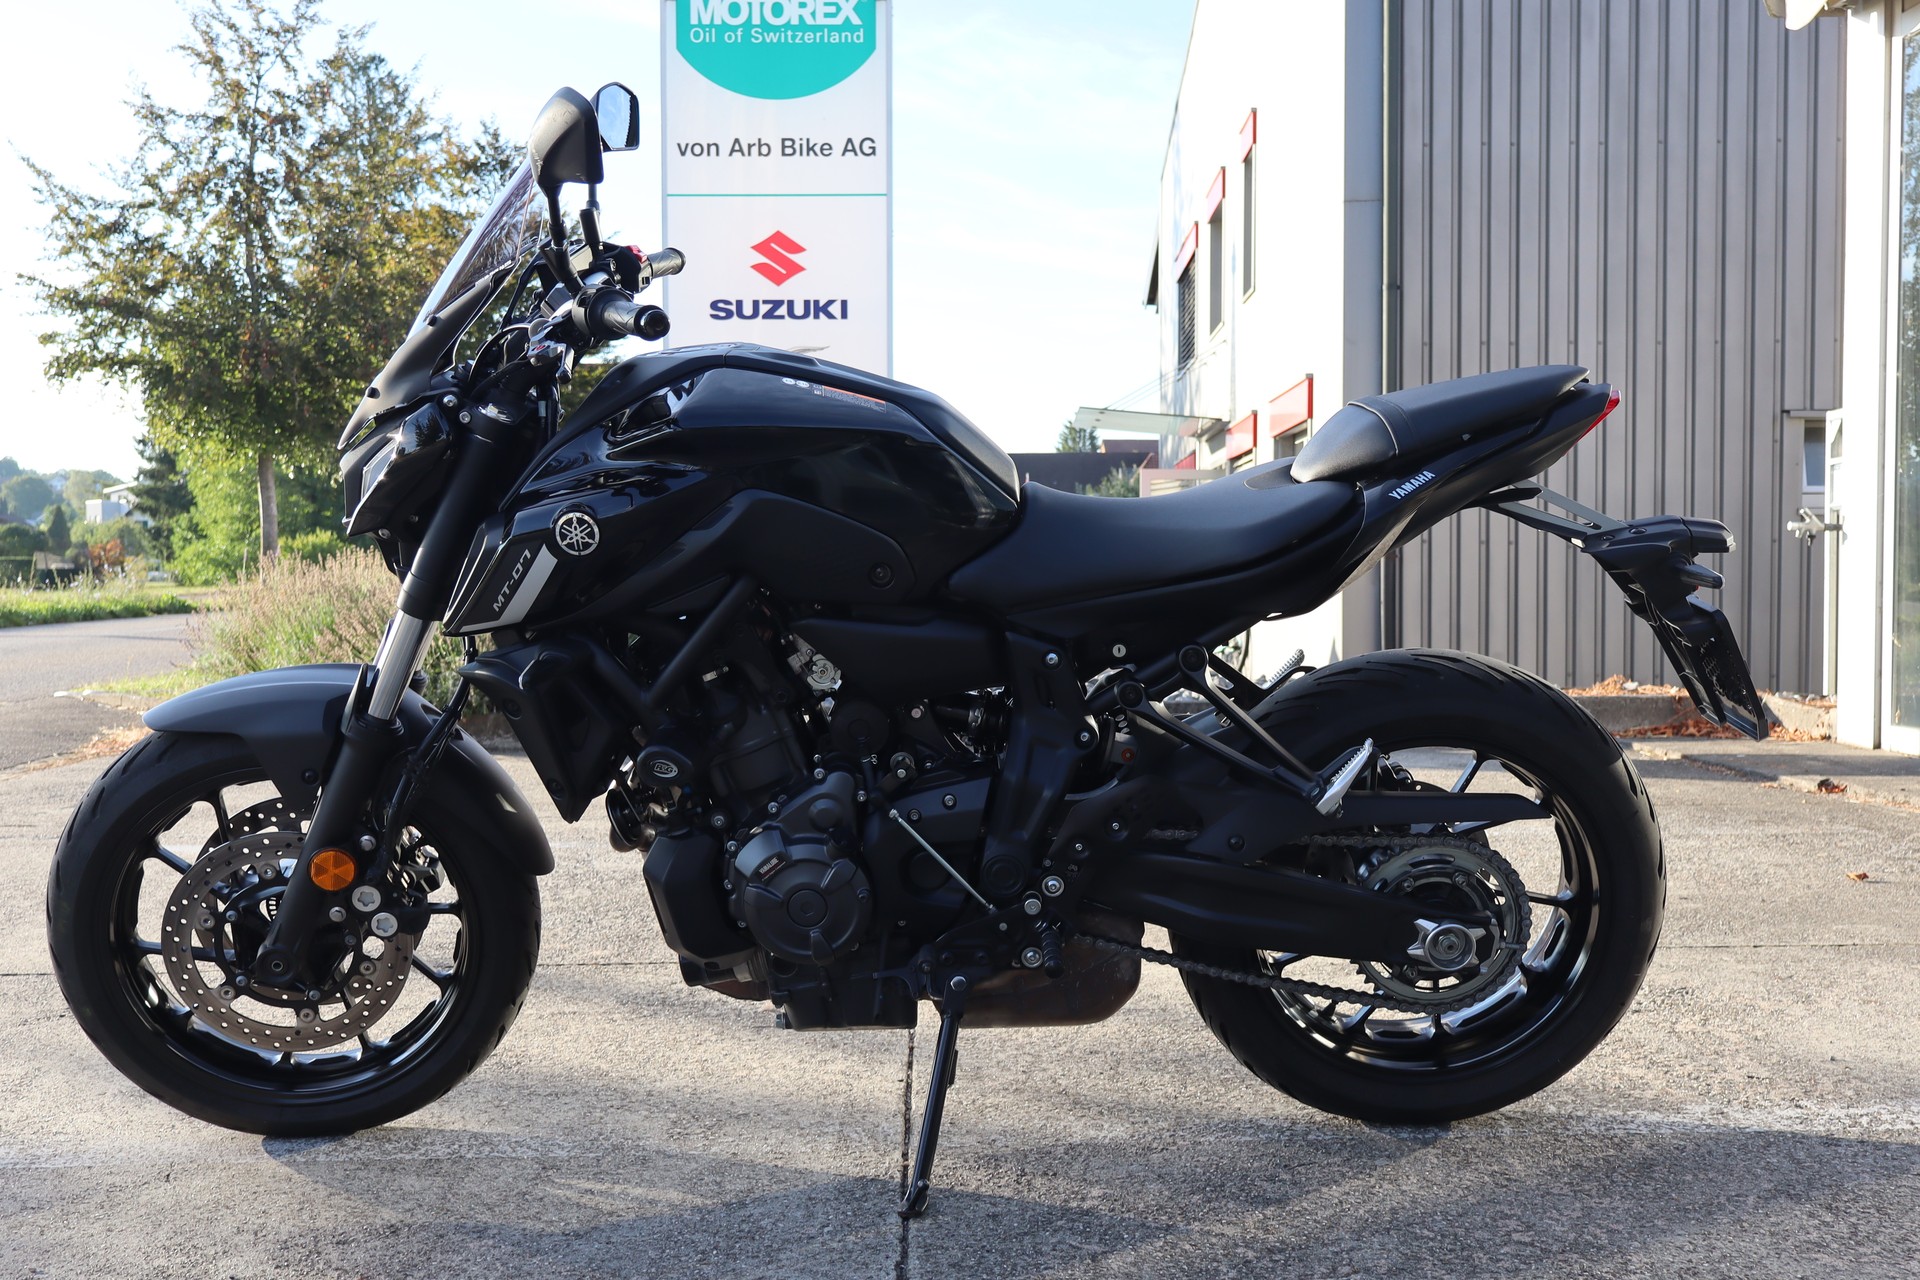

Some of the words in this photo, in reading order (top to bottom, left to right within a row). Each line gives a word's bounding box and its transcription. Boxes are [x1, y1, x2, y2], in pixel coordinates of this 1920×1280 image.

[690, 0, 863, 26] MOTOREX
[690, 27, 716, 43] Oil
[724, 27, 743, 43] of
[751, 27, 864, 43] Switzerland
[677, 143, 720, 157] von
[728, 138, 772, 157] Arb
[781, 138, 833, 157] Bike
[841, 137, 877, 157] AG
[709, 299, 848, 320] SUZUKI
[1388, 470, 1436, 500] YAMAHA
[493, 548, 532, 612] MT-07
